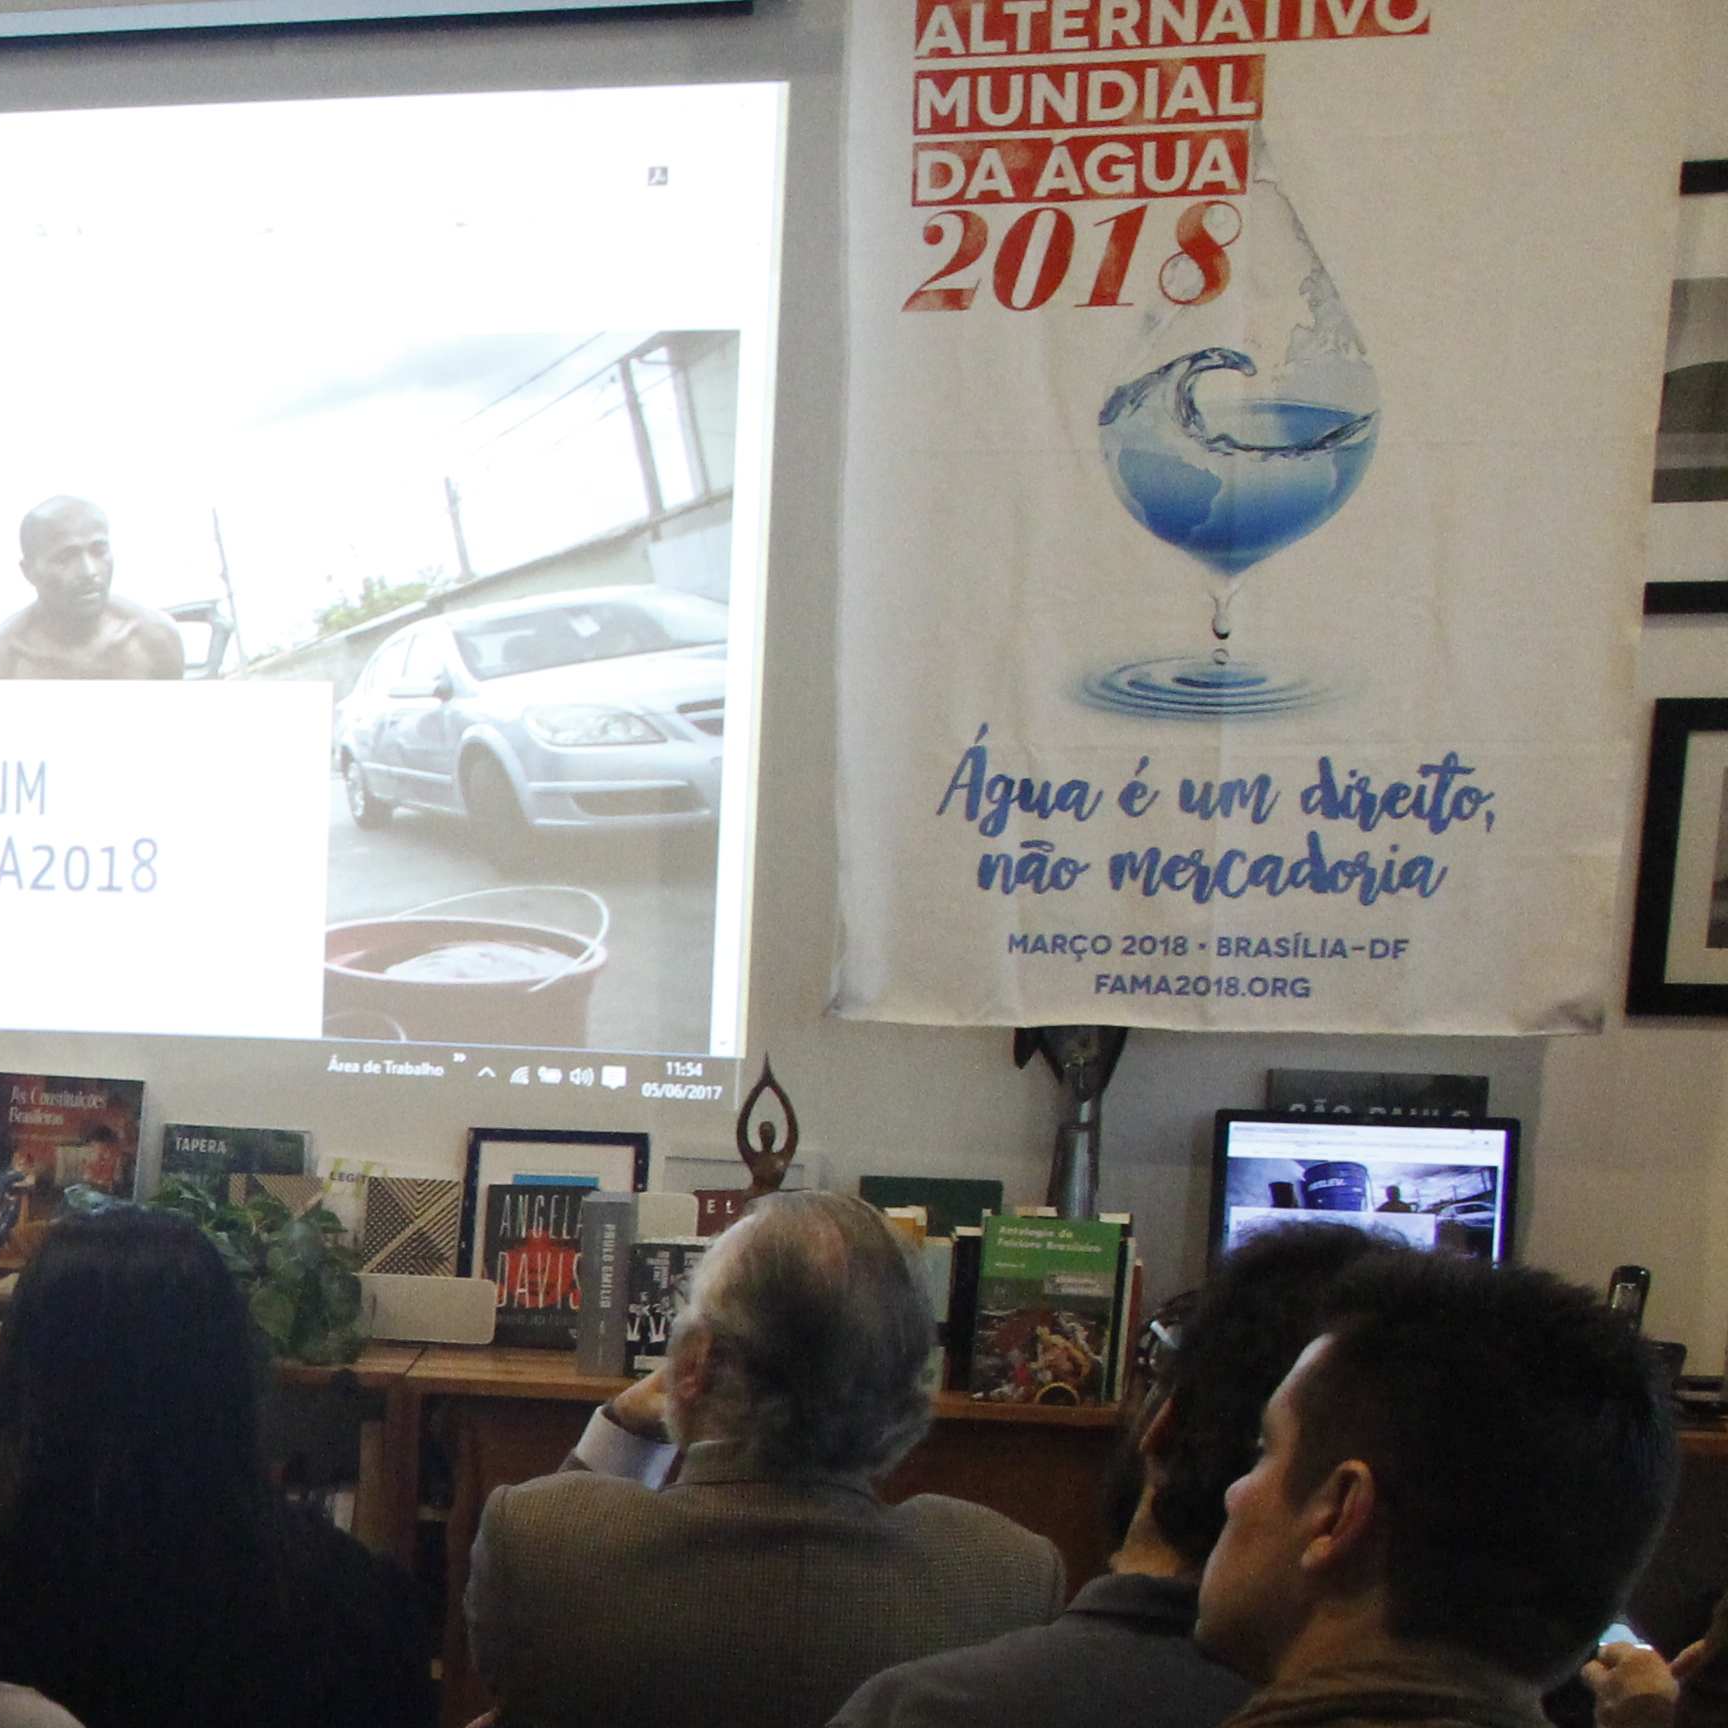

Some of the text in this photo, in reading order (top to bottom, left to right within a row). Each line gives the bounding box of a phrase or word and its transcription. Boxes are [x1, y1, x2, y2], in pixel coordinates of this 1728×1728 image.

[917, 0, 1430, 56] ALTERNATIVO
[917, 63, 1257, 129] MUNDIAL
[916, 137, 1241, 201] DA ÁGUA
[901, 199, 1242, 313] 2018
[936, 722, 1495, 838] Água é um direito,
[977, 830, 1448, 907] não mercadoria
[1008, 932, 1410, 963] MARÇO 2018 BRASÍLIA-DF
[1095, 972, 1312, 999] FAMA2018.ORG
[327, 1054, 445, 1080] Área de Trabalho
[664, 1061, 703, 1079] 11:54
[641, 1082, 723, 1102] 05/06/2017
[175, 1135, 227, 1155] TAPERA
